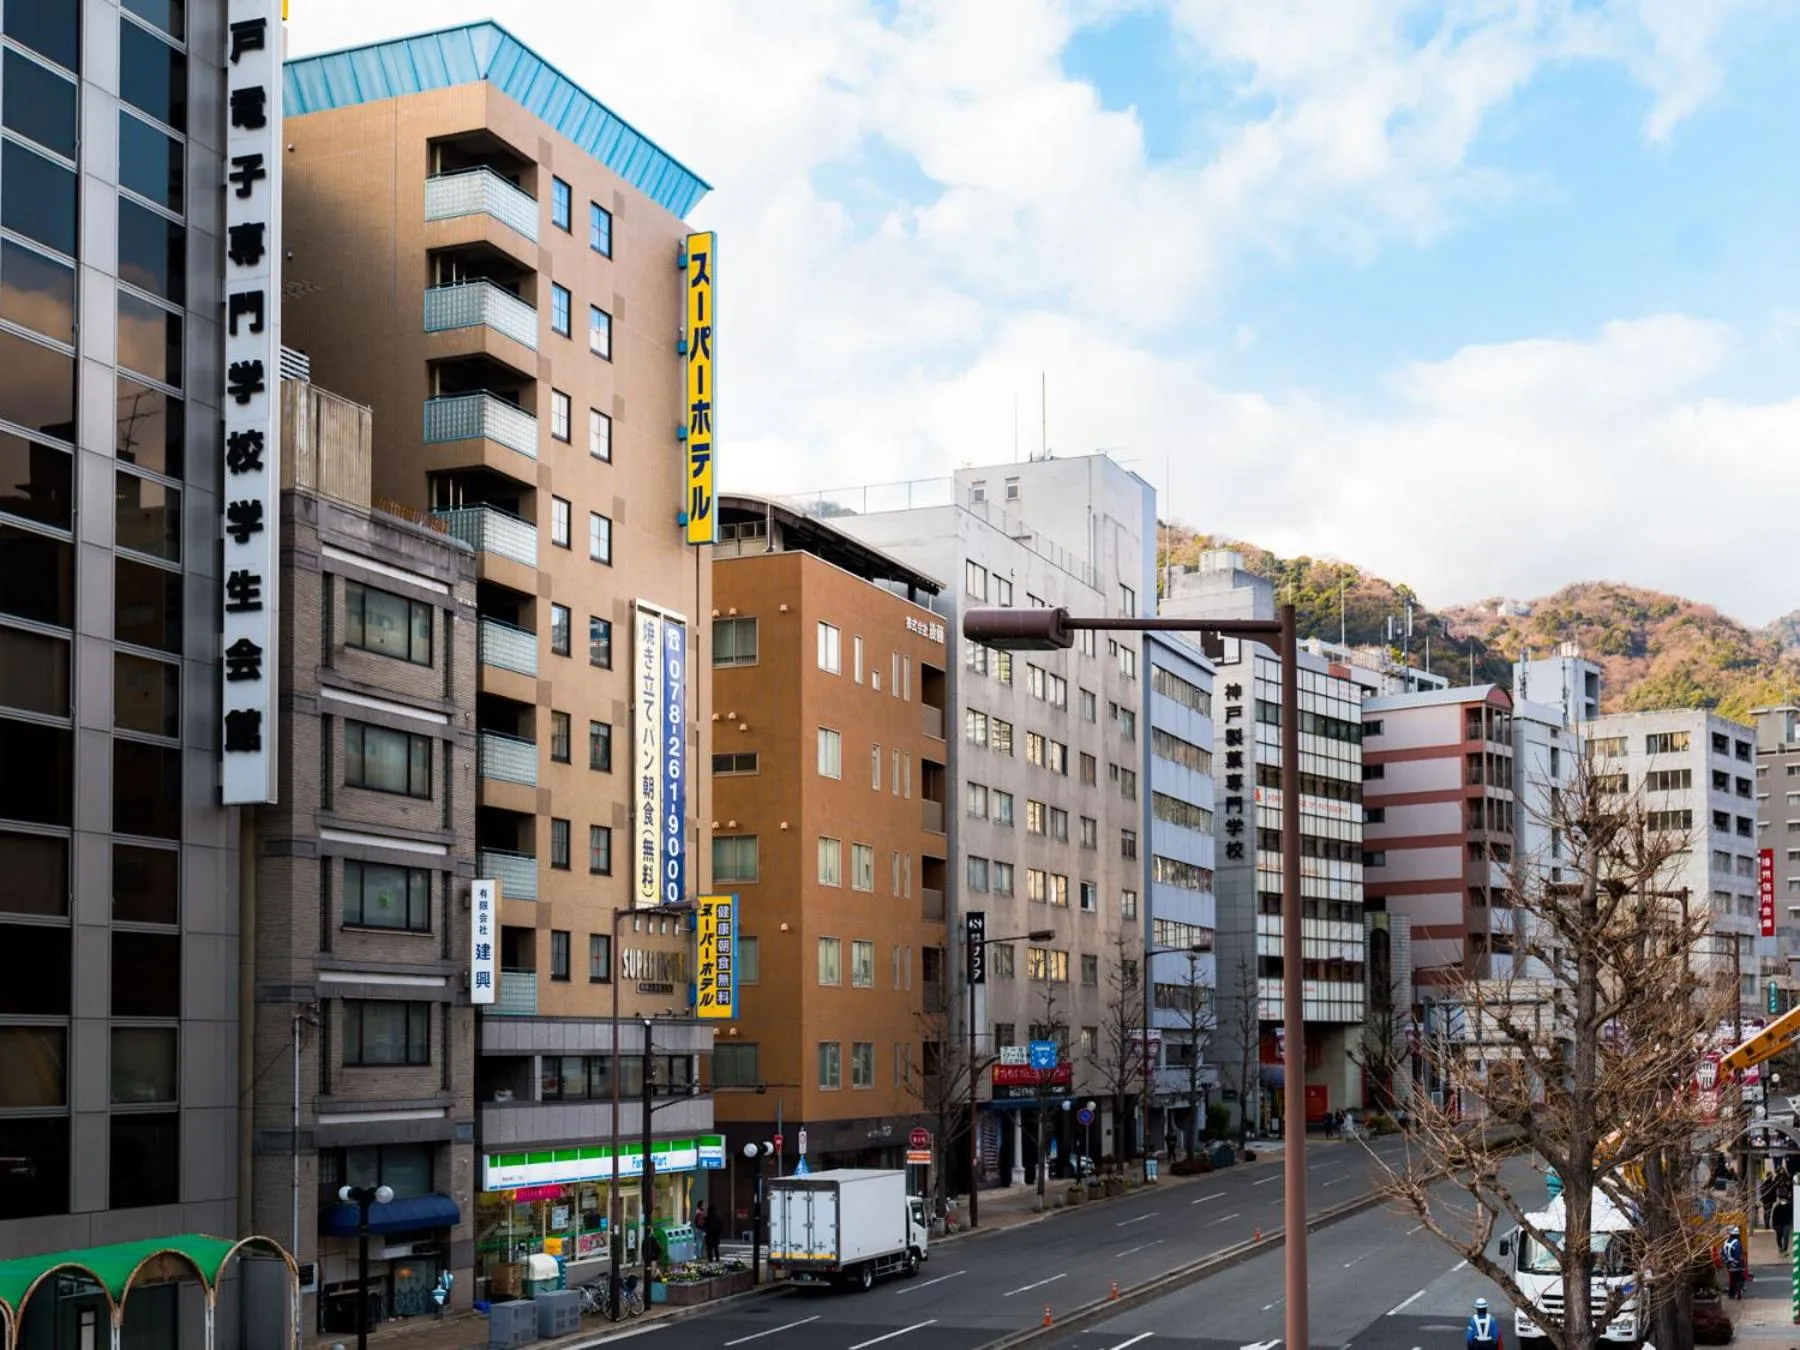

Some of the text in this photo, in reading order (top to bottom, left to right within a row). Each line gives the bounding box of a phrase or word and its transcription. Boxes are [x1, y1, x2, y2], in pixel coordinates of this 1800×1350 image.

[690, 251, 711, 521] スーパーホテル
[668, 659, 681, 902] 078-261-9000
[1224, 682, 1244, 860] 神戸製菓専門学校
[700, 903, 714, 1007] スーパーホテル
[717, 904, 731, 1006] 健康朝食無料
